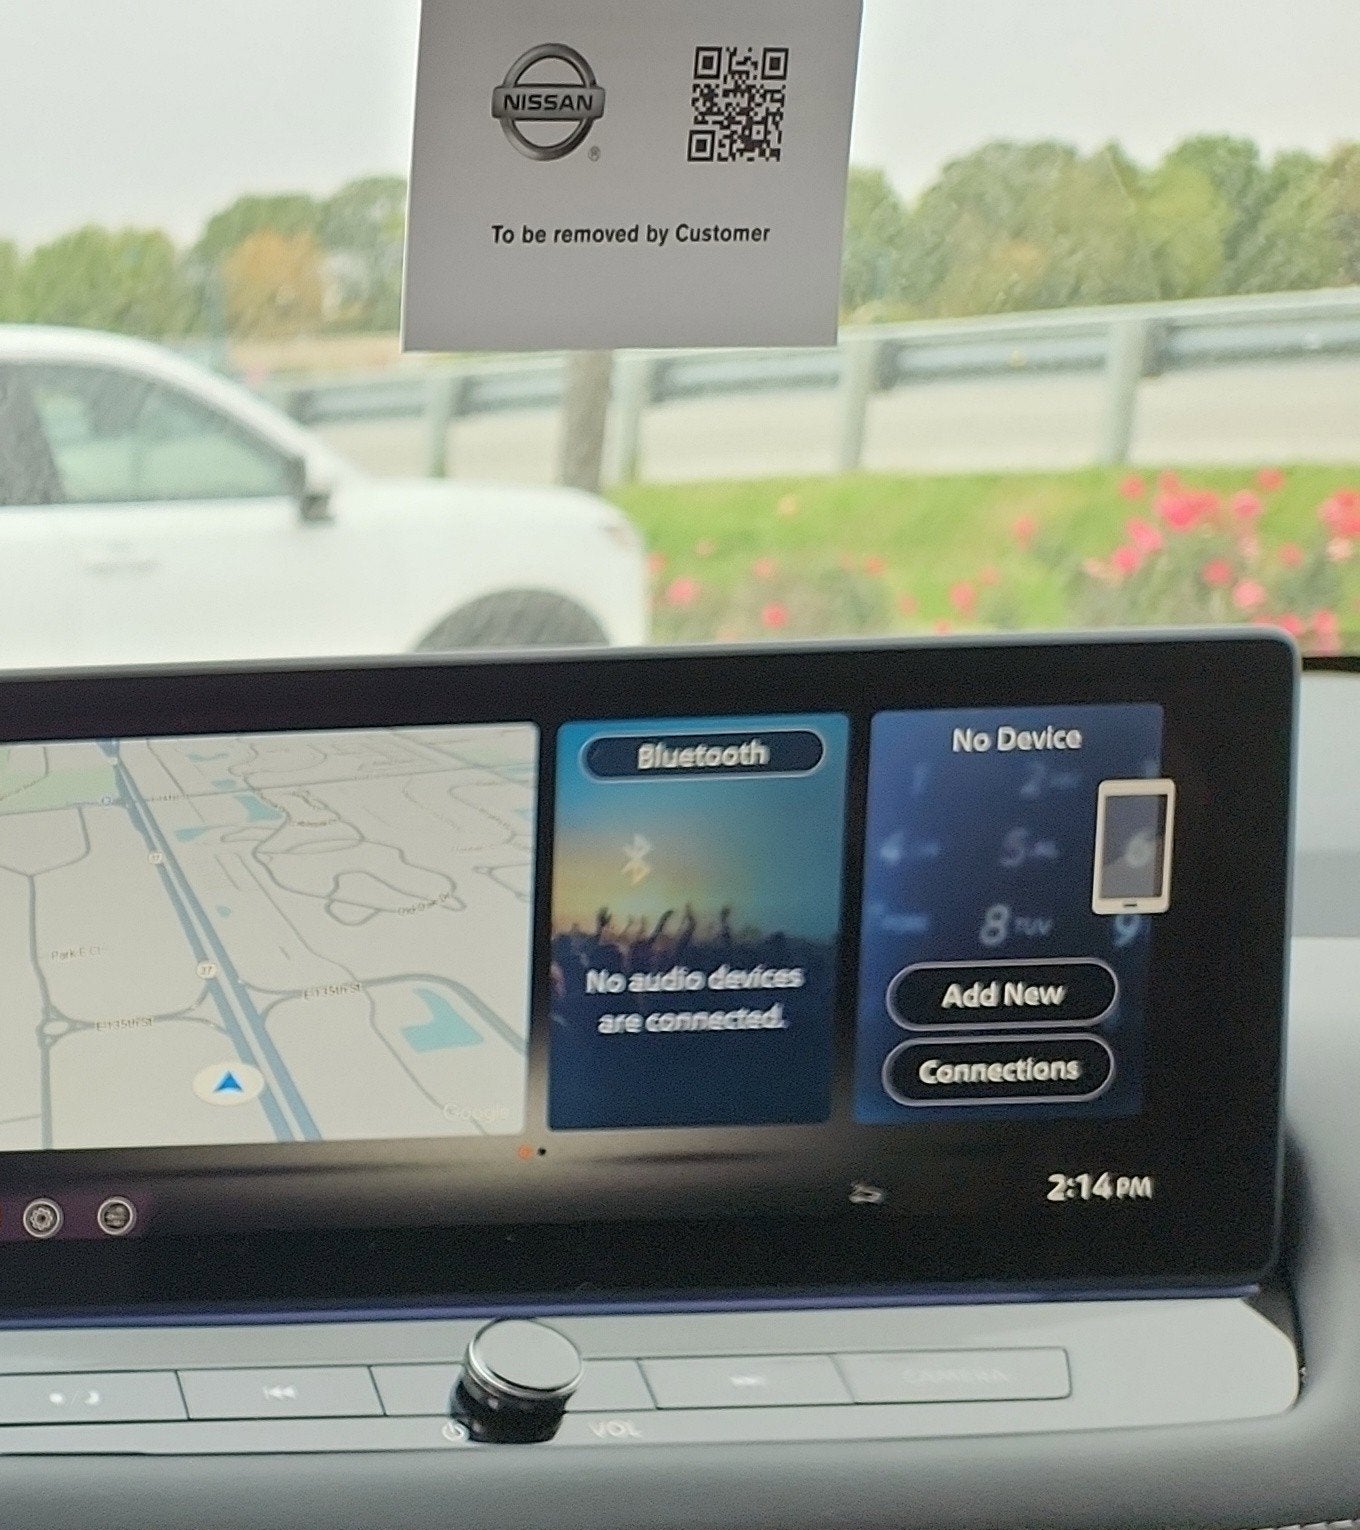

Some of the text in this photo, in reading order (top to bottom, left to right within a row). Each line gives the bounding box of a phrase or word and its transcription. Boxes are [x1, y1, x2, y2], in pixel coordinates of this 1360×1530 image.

[503, 93, 594, 111] NISSAN
[491, 223, 770, 247] To be removed by Customer
[952, 725, 1082, 752] No Device
[637, 740, 771, 770] Bluetooth
[980, 903, 1009, 945] 8
[586, 962, 804, 994] No audio devices
[940, 981, 1065, 1009] Add New
[598, 1013, 643, 1034] are
[917, 1056, 1082, 1085] Connections
[1046, 1173, 1152, 1202] 2:14 PM
[588, 1421, 641, 1438] VOL
